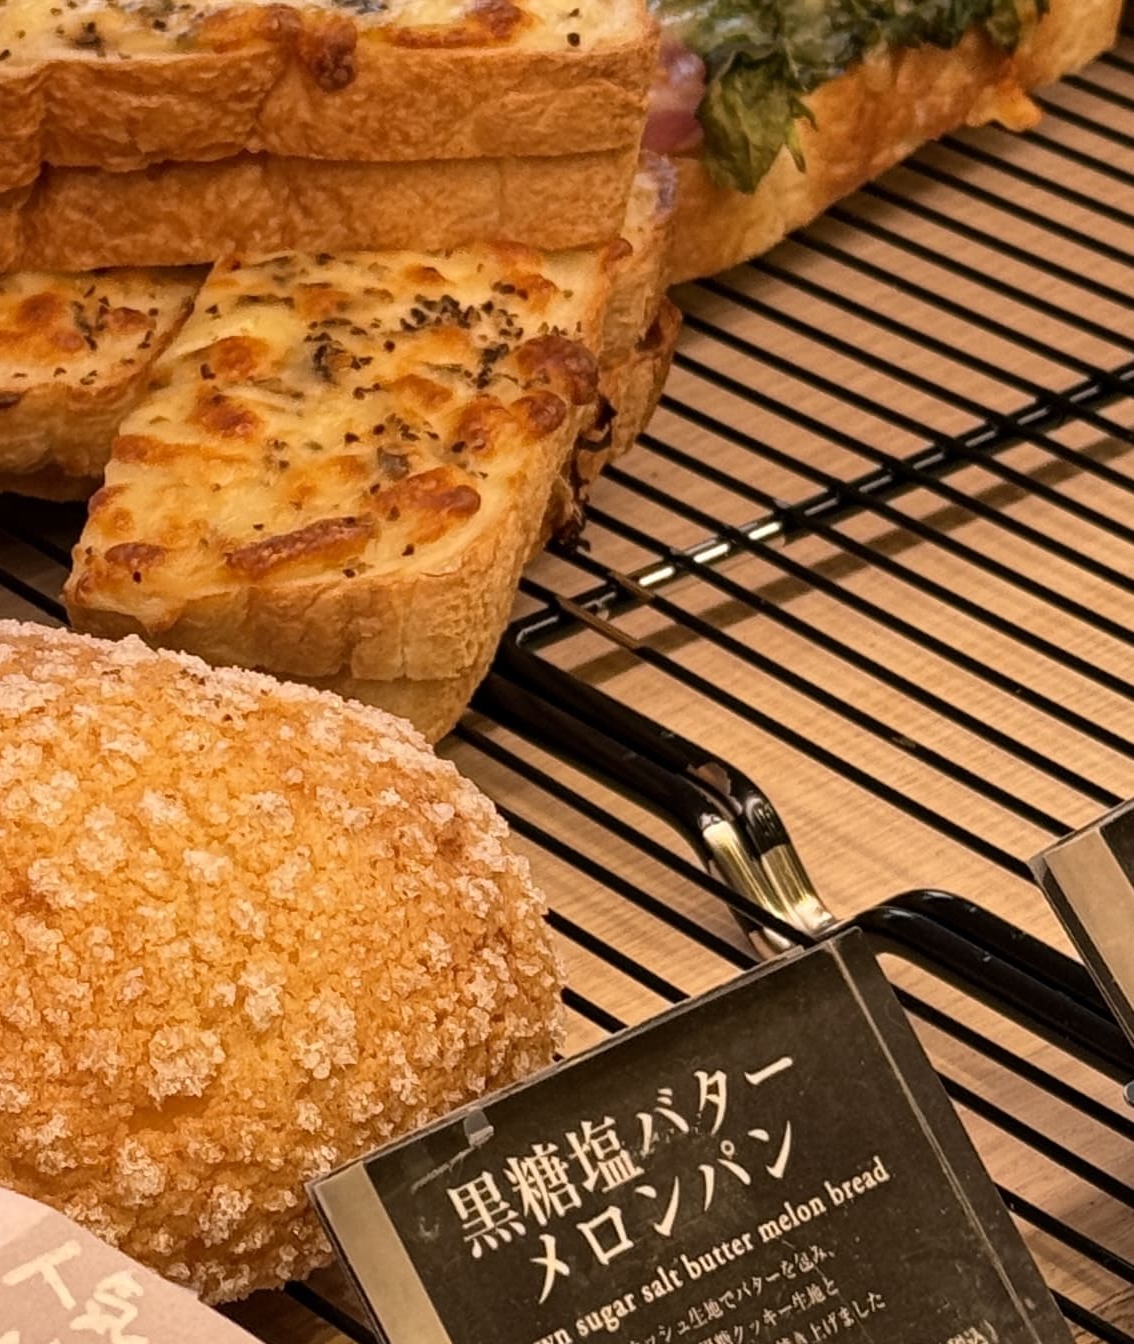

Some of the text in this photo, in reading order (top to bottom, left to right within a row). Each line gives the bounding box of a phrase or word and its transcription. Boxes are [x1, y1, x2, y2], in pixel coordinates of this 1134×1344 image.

[448, 1057, 794, 1258] 黒糖塩バター
[532, 1120, 792, 1304] メロンパン
[576, 1293, 637, 1338] sugar
[641, 1266, 684, 1304] salt
[682, 1233, 755, 1276] butter
[758, 1197, 827, 1243] melon
[825, 1156, 891, 1205] bread
